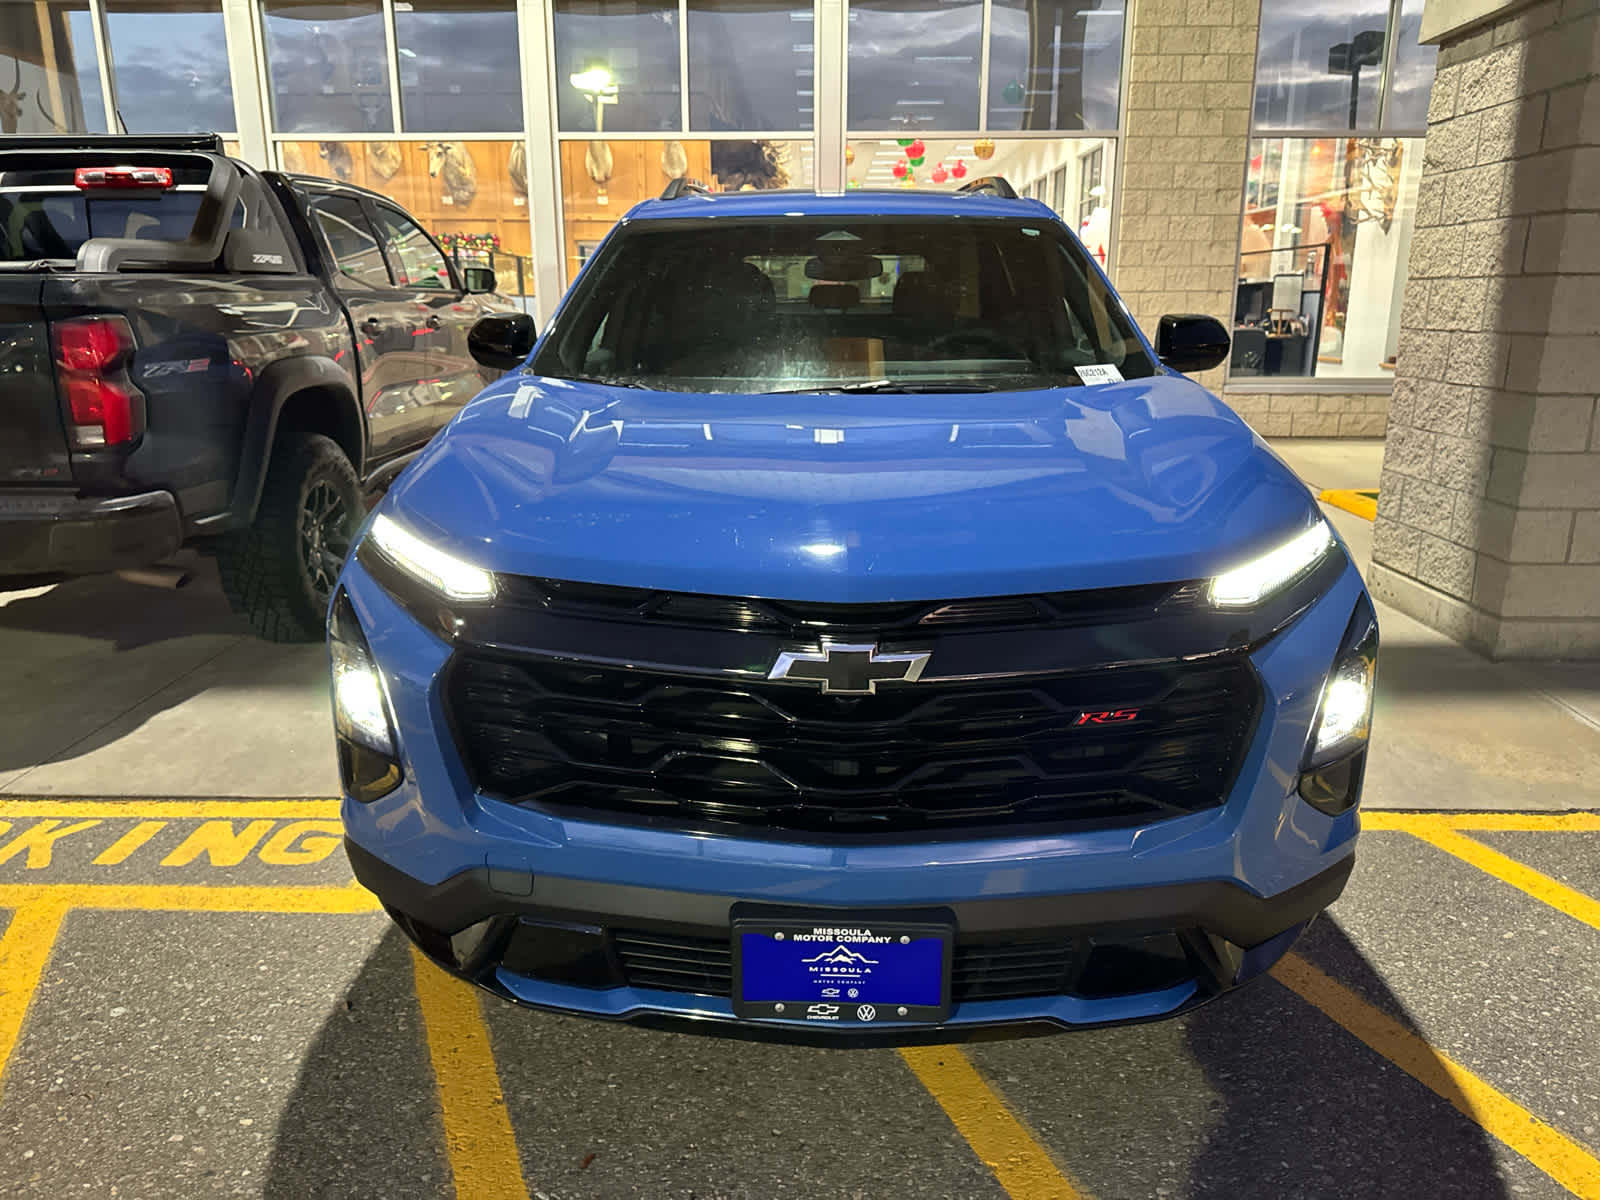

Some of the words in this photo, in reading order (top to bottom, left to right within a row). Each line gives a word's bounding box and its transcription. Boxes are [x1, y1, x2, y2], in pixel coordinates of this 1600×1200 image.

[1076, 708, 1141, 725] RS
[813, 928, 872, 937] MISSOULA
[793, 934, 833, 942] MOTOR
[836, 935, 892, 943] COMPANY
